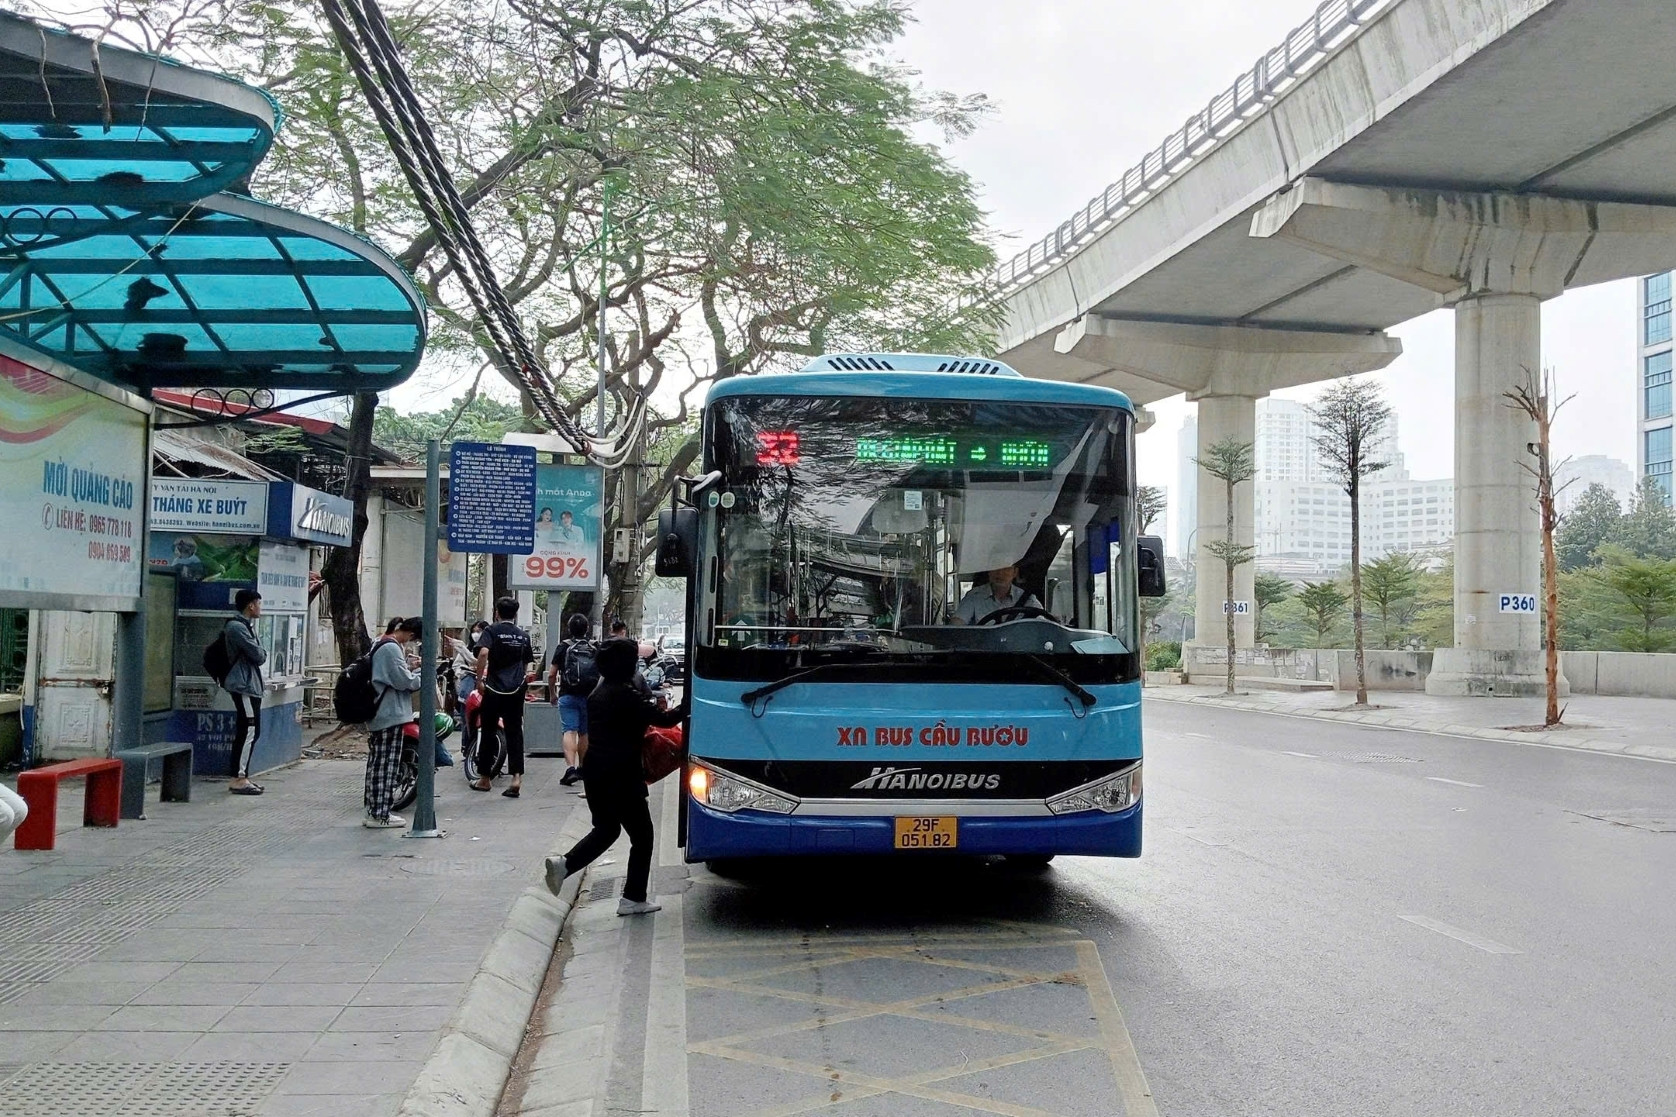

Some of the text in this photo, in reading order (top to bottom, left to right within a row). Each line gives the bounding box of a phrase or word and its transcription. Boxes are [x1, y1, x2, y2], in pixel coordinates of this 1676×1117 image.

[113, 474, 133, 510] CÁO
[153, 494, 248, 516] THÁNG XE BUÝT
[526, 556, 589, 579] 99%
[1501, 596, 1535, 611] P360
[875, 727, 914, 746] BUS
[919, 718, 961, 746] CẦU
[850, 767, 1000, 790] HANOIBUS
[913, 819, 940, 832] 29F
[902, 833, 950, 847] 051.82
